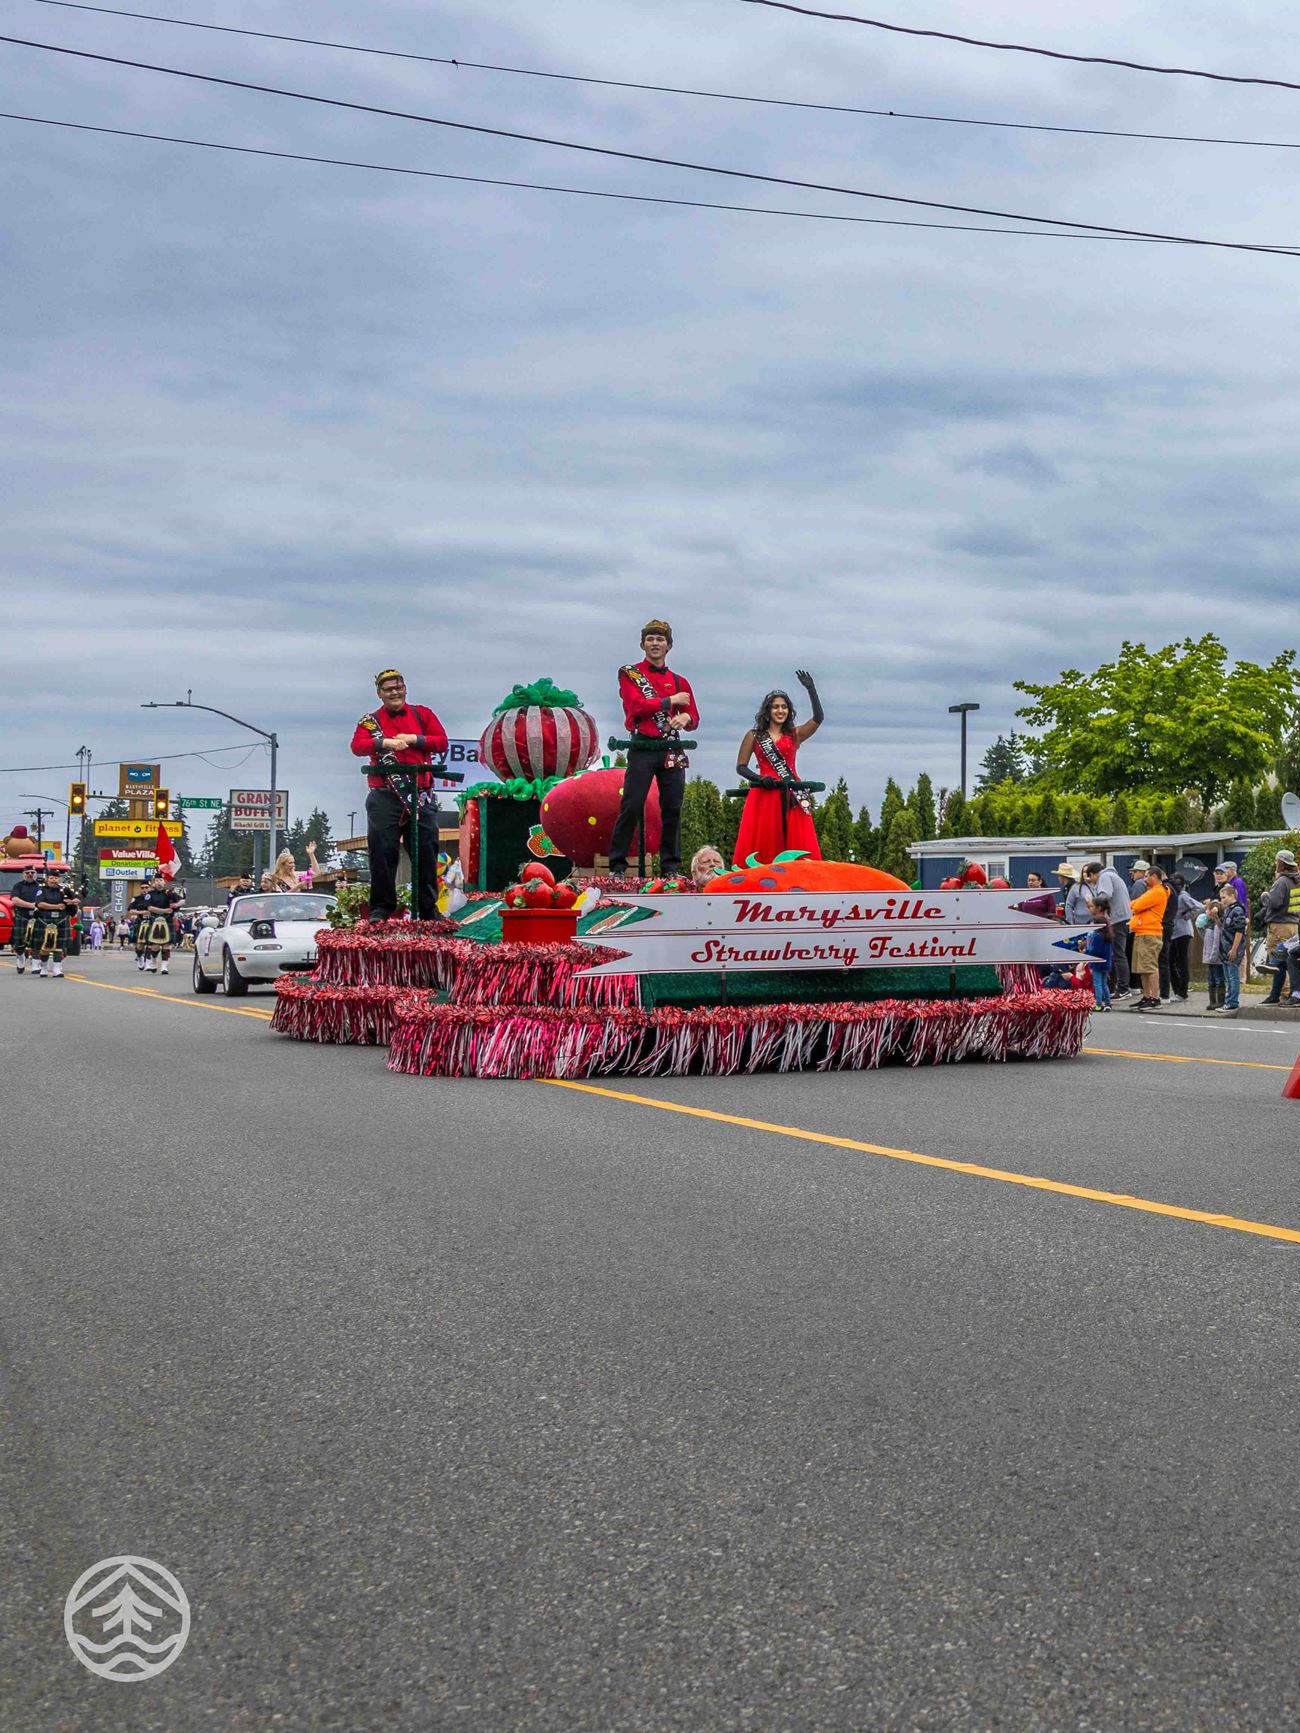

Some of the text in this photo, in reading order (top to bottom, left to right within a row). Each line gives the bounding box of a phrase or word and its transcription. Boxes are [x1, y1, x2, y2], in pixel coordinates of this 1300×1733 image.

[182, 799, 220, 808] 76th St NE
[237, 792, 282, 804] GRAND
[98, 823, 180, 834] planet fitss
[115, 868, 138, 876] Outlet
[114, 880, 124, 912] CHASE
[733, 898, 945, 928] Marysville
[691, 936, 977, 966] Strawberry Festival
